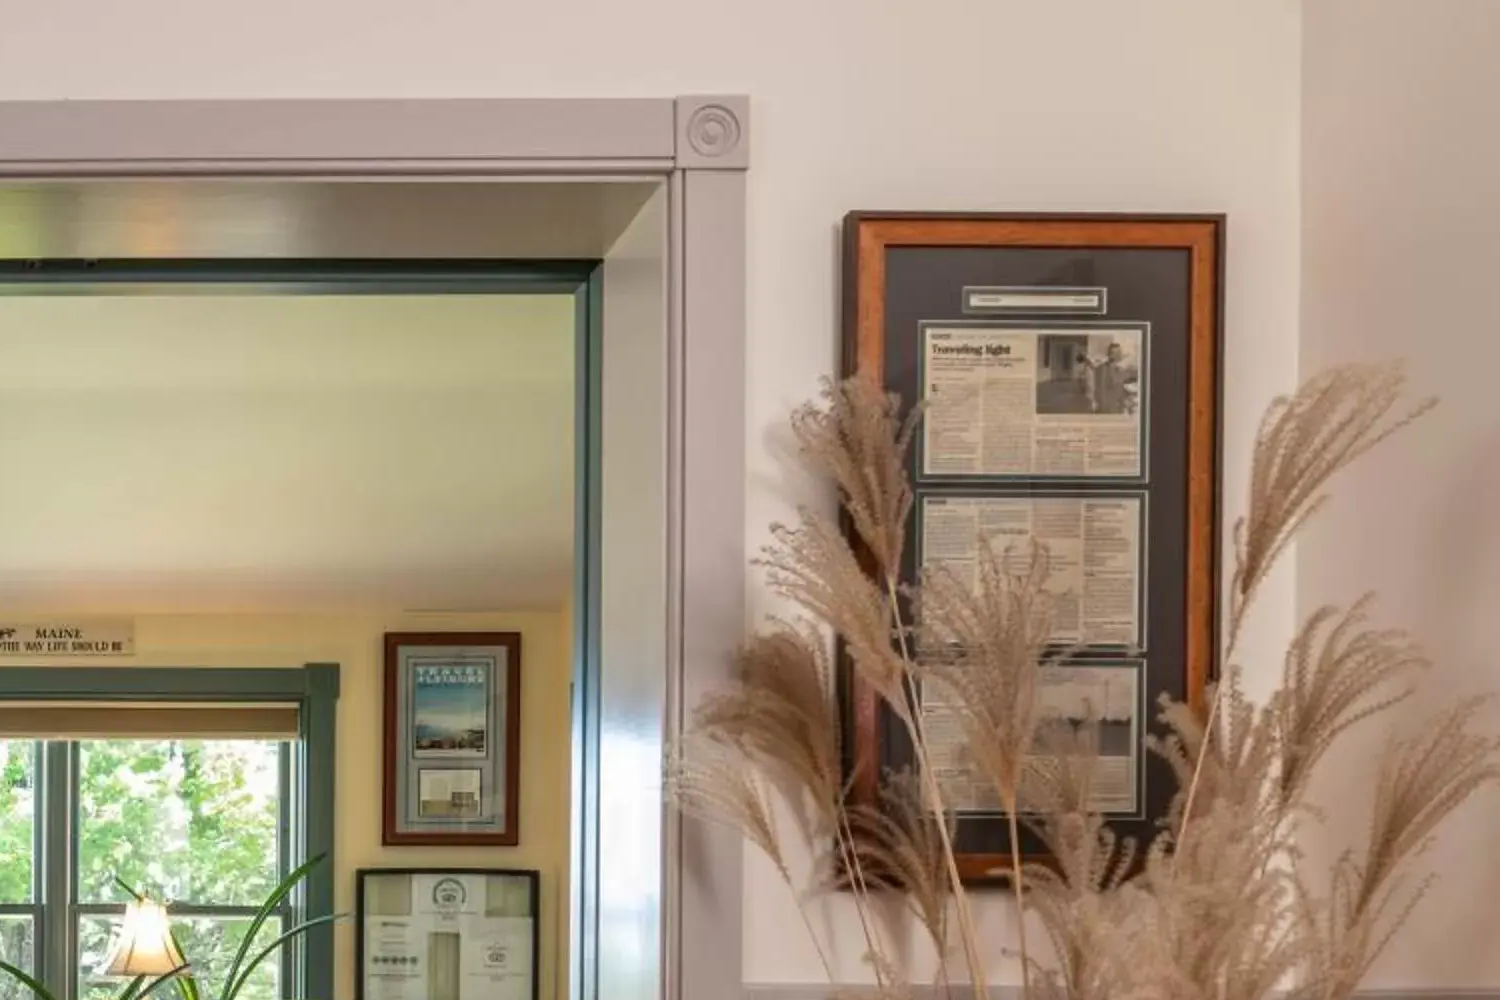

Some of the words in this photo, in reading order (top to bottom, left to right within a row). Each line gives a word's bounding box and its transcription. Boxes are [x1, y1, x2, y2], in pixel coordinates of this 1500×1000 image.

[35, 627, 83, 640] MAINE
[3, 641, 20, 652] THE
[24, 641, 45, 652] WAY
[48, 641, 68, 652] LIFE
[71, 641, 109, 652] SHOULD
[111, 641, 123, 652] BE
